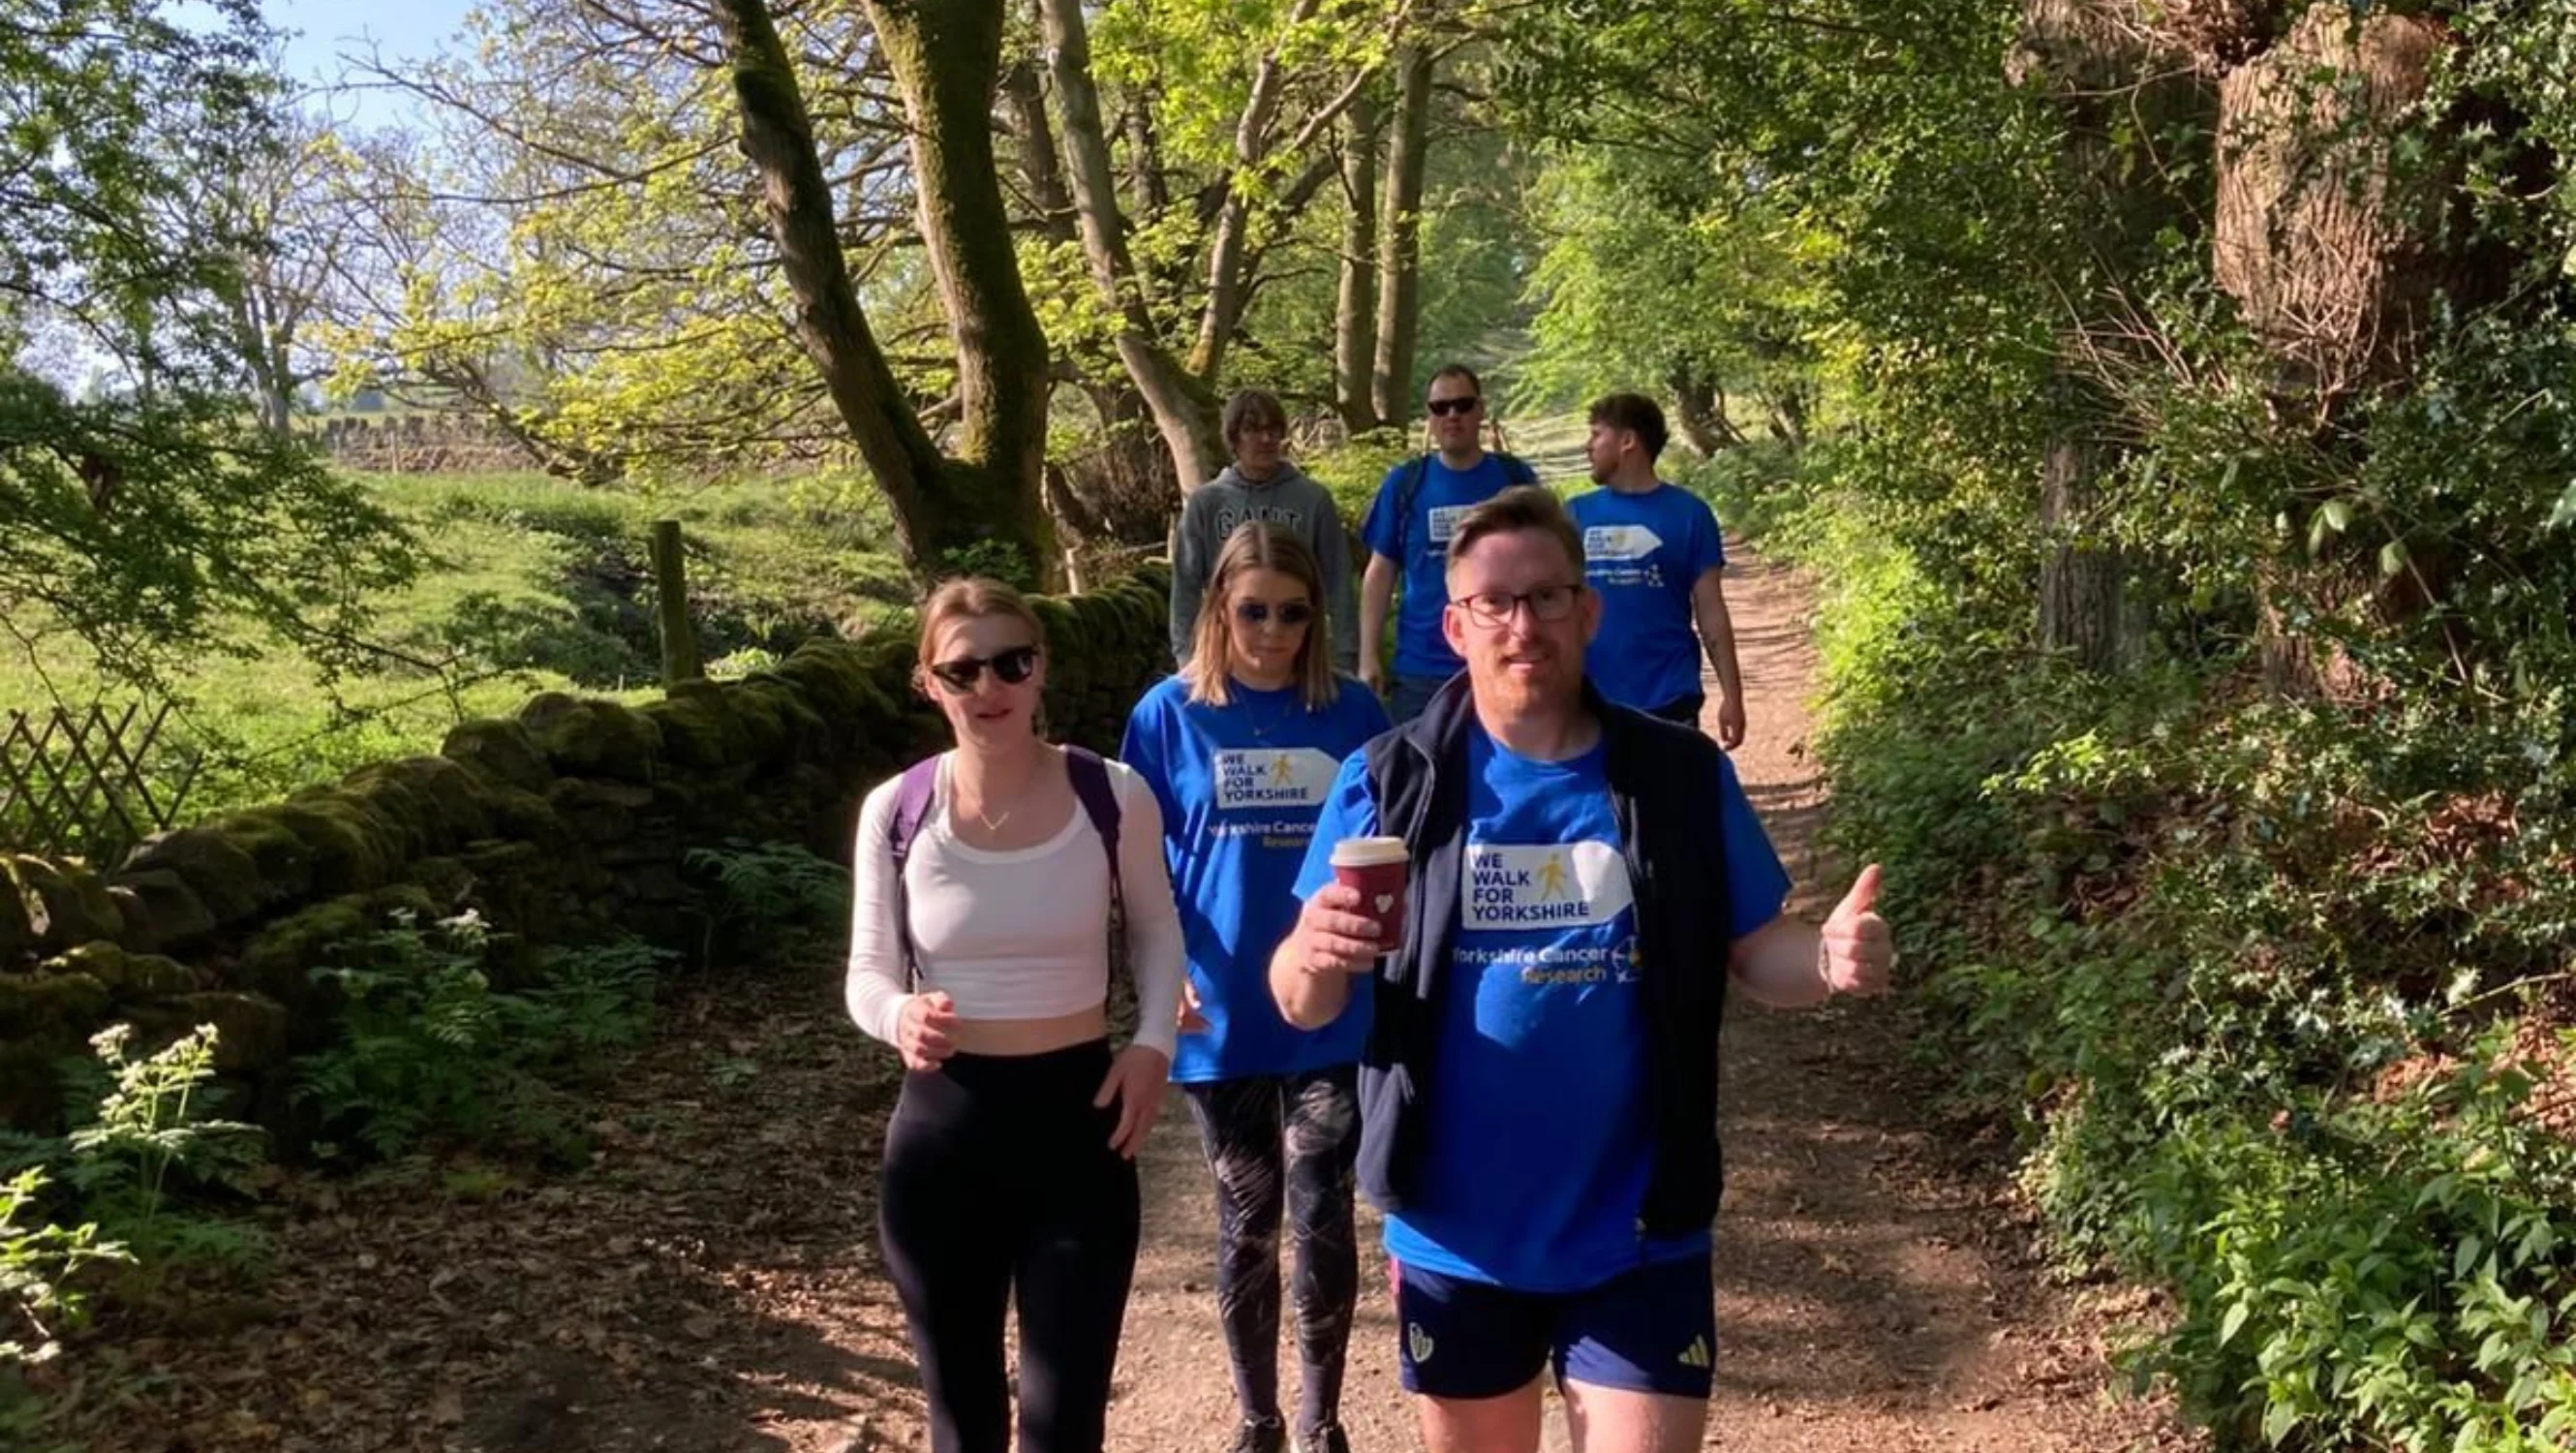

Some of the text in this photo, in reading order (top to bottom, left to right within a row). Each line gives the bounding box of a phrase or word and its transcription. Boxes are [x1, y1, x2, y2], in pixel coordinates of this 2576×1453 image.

[1223, 754, 1244, 764] WE
[1223, 764, 1267, 776] WALK
[1223, 777, 1254, 788] FOR
[1223, 788, 1308, 803] YORKSHIRE
[1273, 819, 1317, 834] Cance
[1474, 852, 1503, 870] WE
[1472, 870, 1530, 886] WALK
[1472, 886, 1515, 904] FOR
[1472, 901, 1590, 922] YORKSHIRE
[1538, 945, 1608, 965] Cancer
